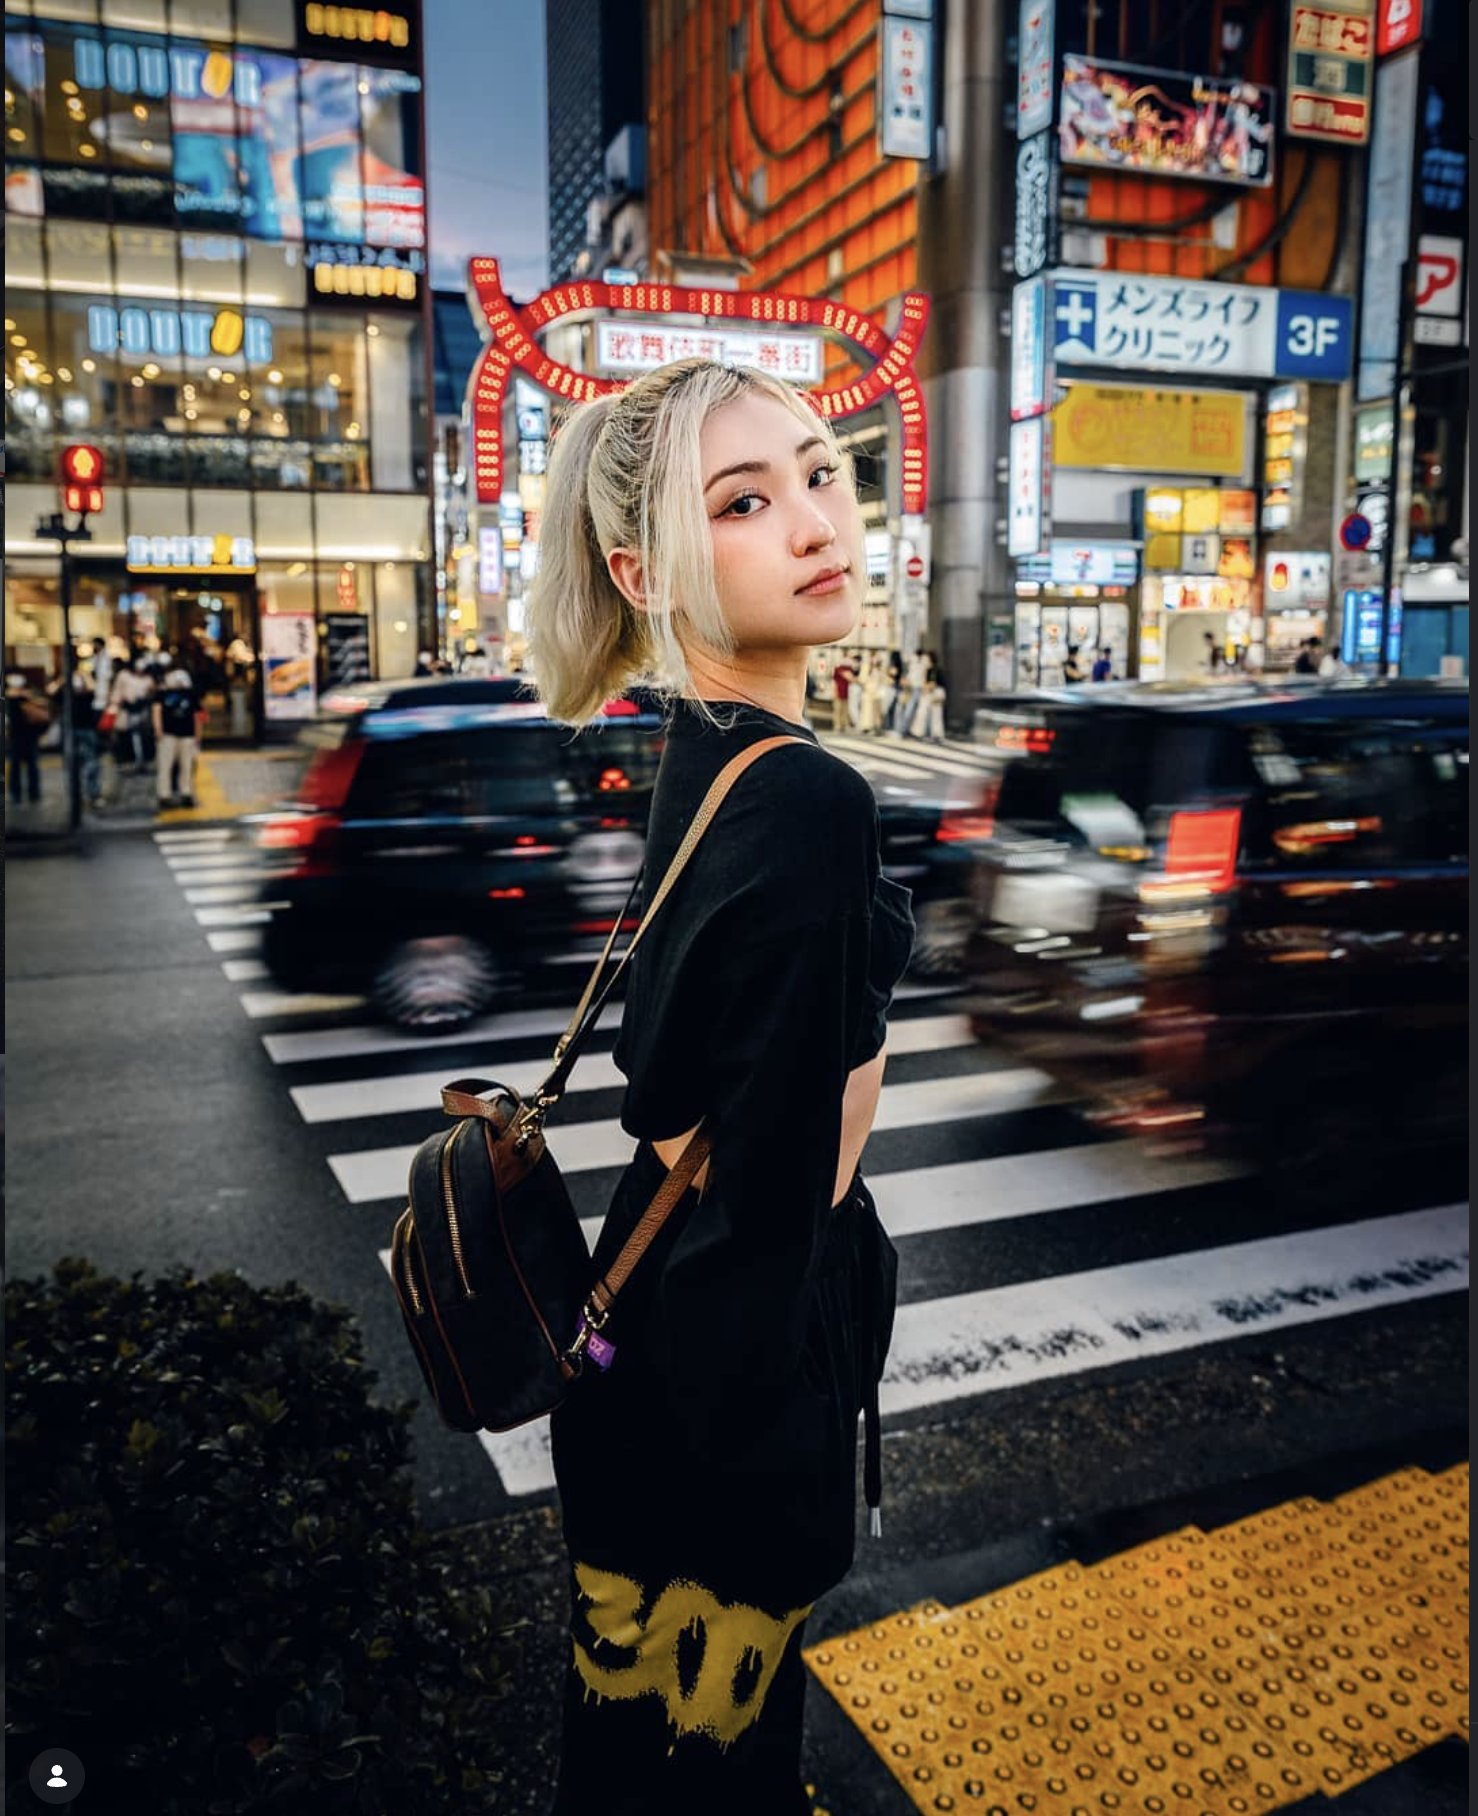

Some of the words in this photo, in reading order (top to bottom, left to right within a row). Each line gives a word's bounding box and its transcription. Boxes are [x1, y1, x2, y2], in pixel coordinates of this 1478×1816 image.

[1104, 283, 1262, 325] メンズライフ
[1102, 324, 1232, 366] クリニック
[1286, 314, 1341, 356] 3F
